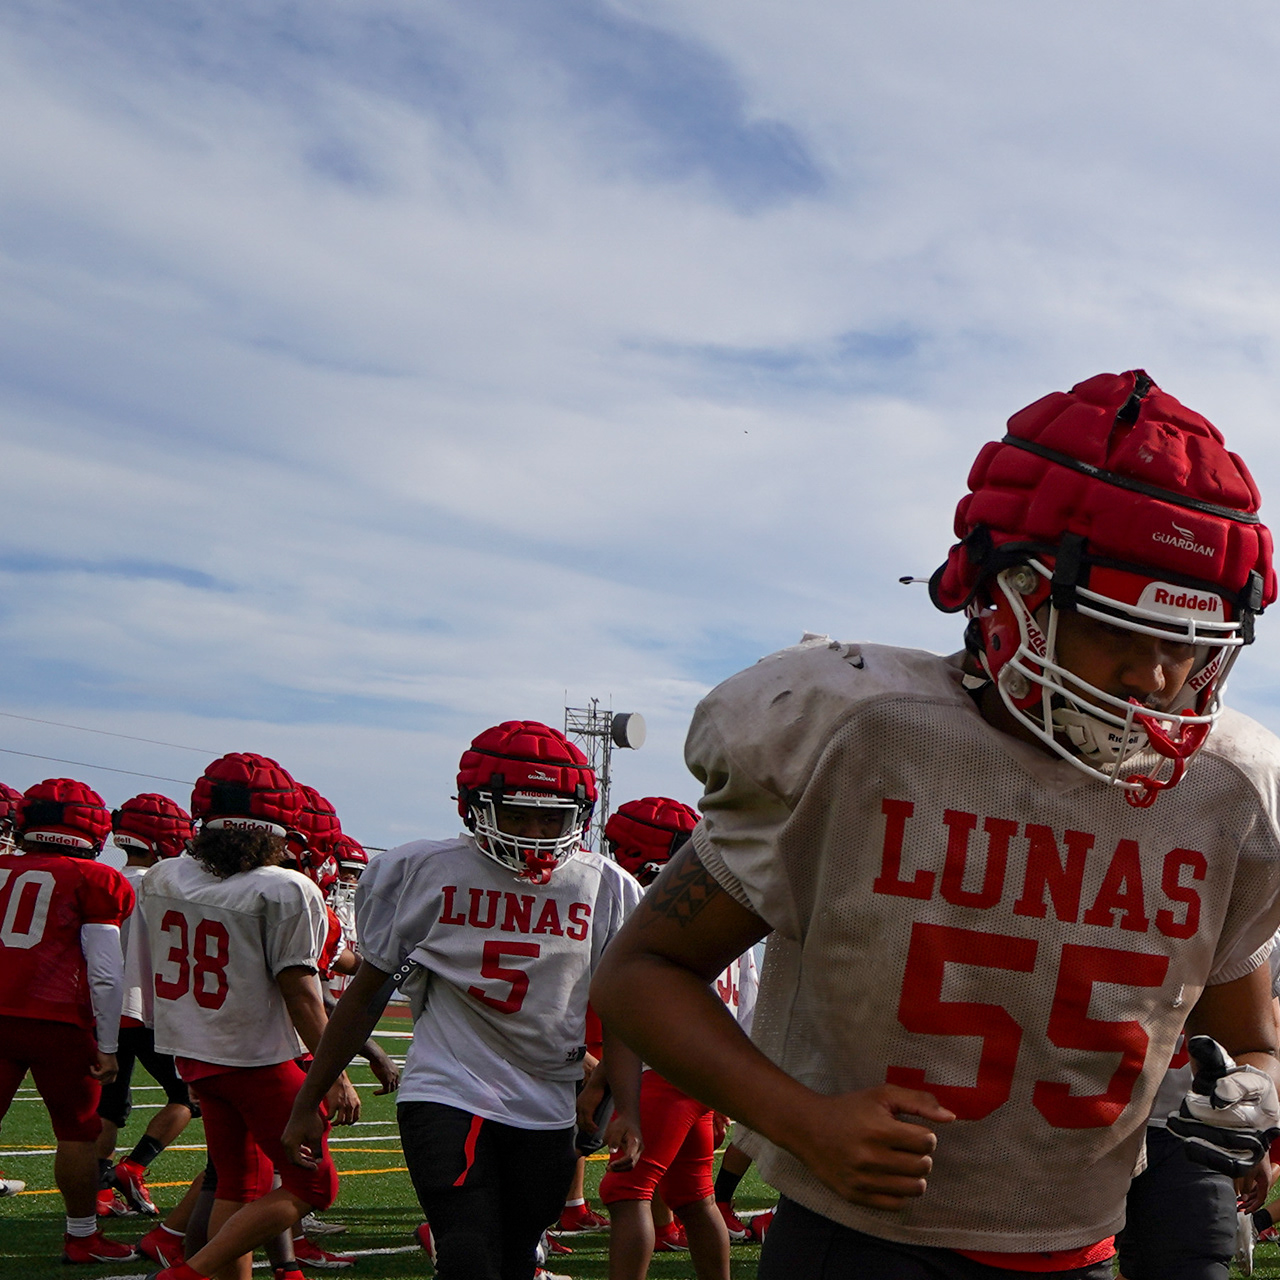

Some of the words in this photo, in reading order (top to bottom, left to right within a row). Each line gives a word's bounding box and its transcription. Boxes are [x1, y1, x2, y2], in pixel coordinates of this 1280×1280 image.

[1152, 531, 1215, 558] GUARDIAN
[1154, 588, 1218, 612] Riddell
[527, 773, 557, 783] GUARDIAN
[35, 833, 80, 847] Riddell
[873, 798, 1208, 940] LUNAS
[438, 885, 592, 942] LUNAS
[154, 909, 230, 1010] 38
[467, 940, 540, 1015] 5
[884, 920, 1170, 1130] 55
